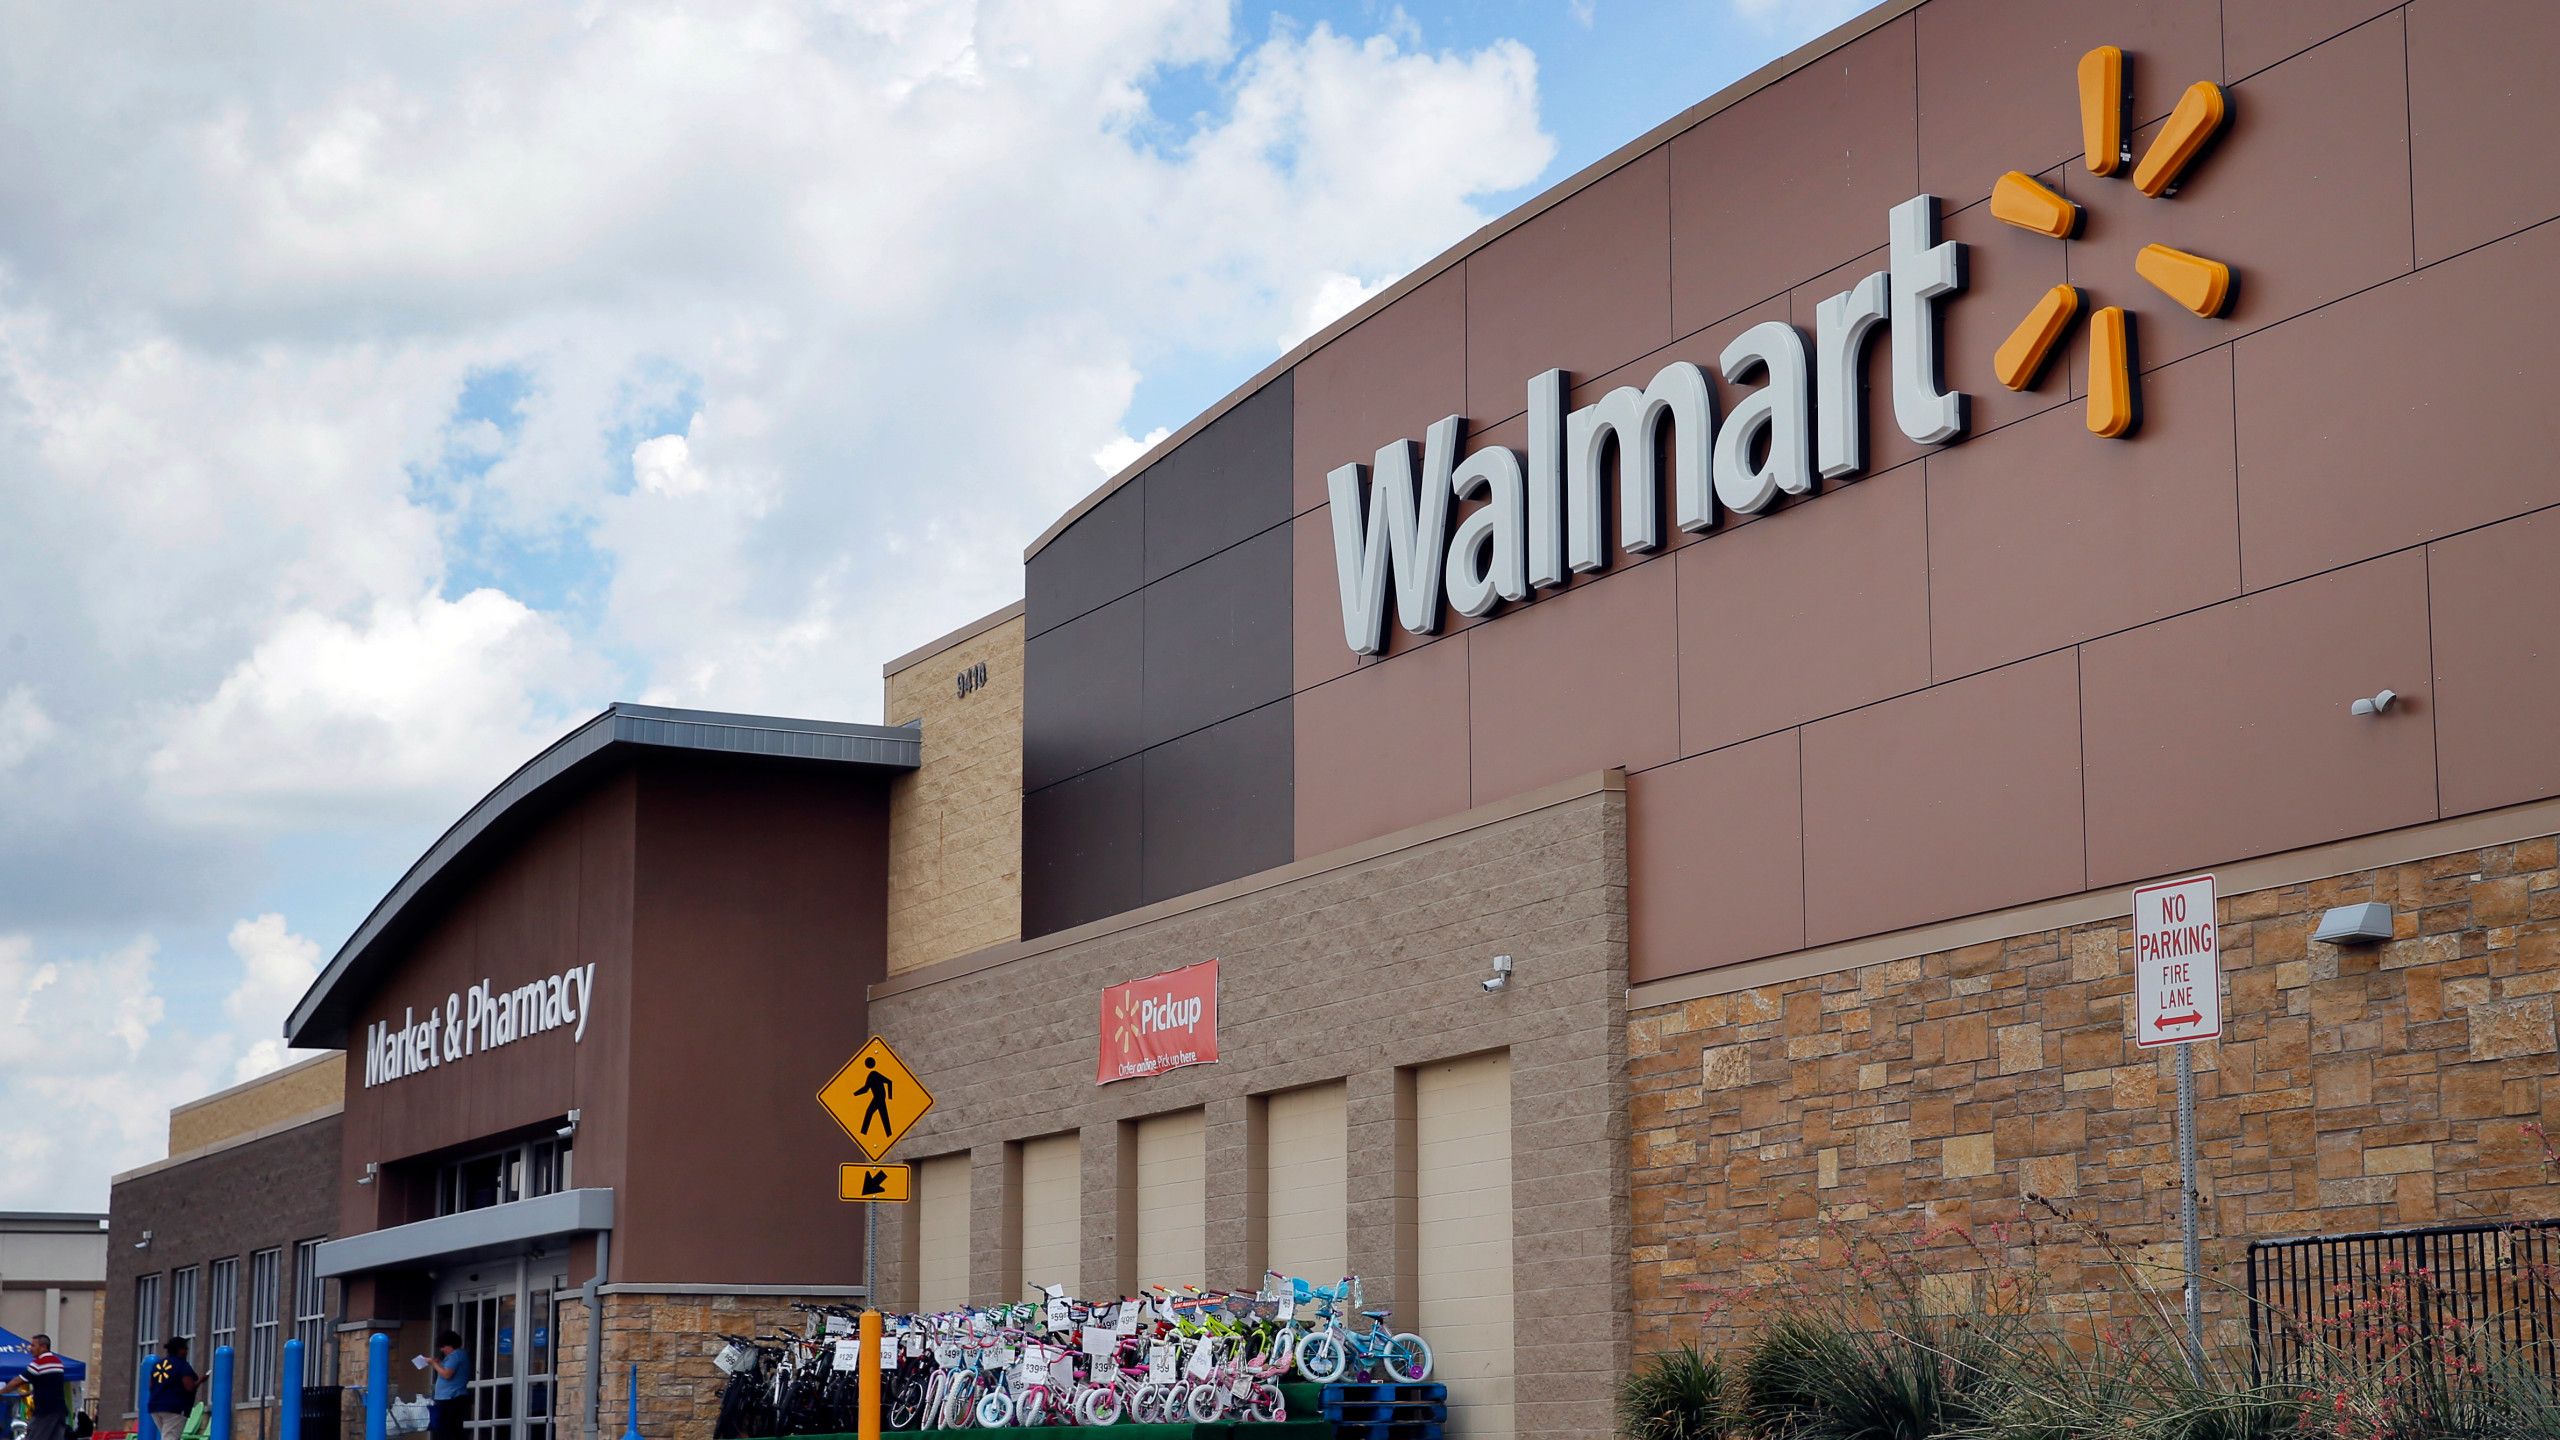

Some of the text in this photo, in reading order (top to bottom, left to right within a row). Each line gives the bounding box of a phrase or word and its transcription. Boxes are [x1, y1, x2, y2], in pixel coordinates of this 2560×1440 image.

[1327, 194, 1969, 656] Walmart
[2162, 893, 2186, 925] NO
[2140, 923, 2212, 962] PARKING
[2163, 963, 2190, 985] FIRE
[1142, 992, 1201, 1035] Pickup
[2160, 987, 2194, 1010] LANE
[365, 962, 595, 1088] Market & Pharmacy
[1118, 1061, 1136, 1077] Order
[1157, 1053, 1171, 1068] Pick
[1170, 1055, 1179, 1067] up
